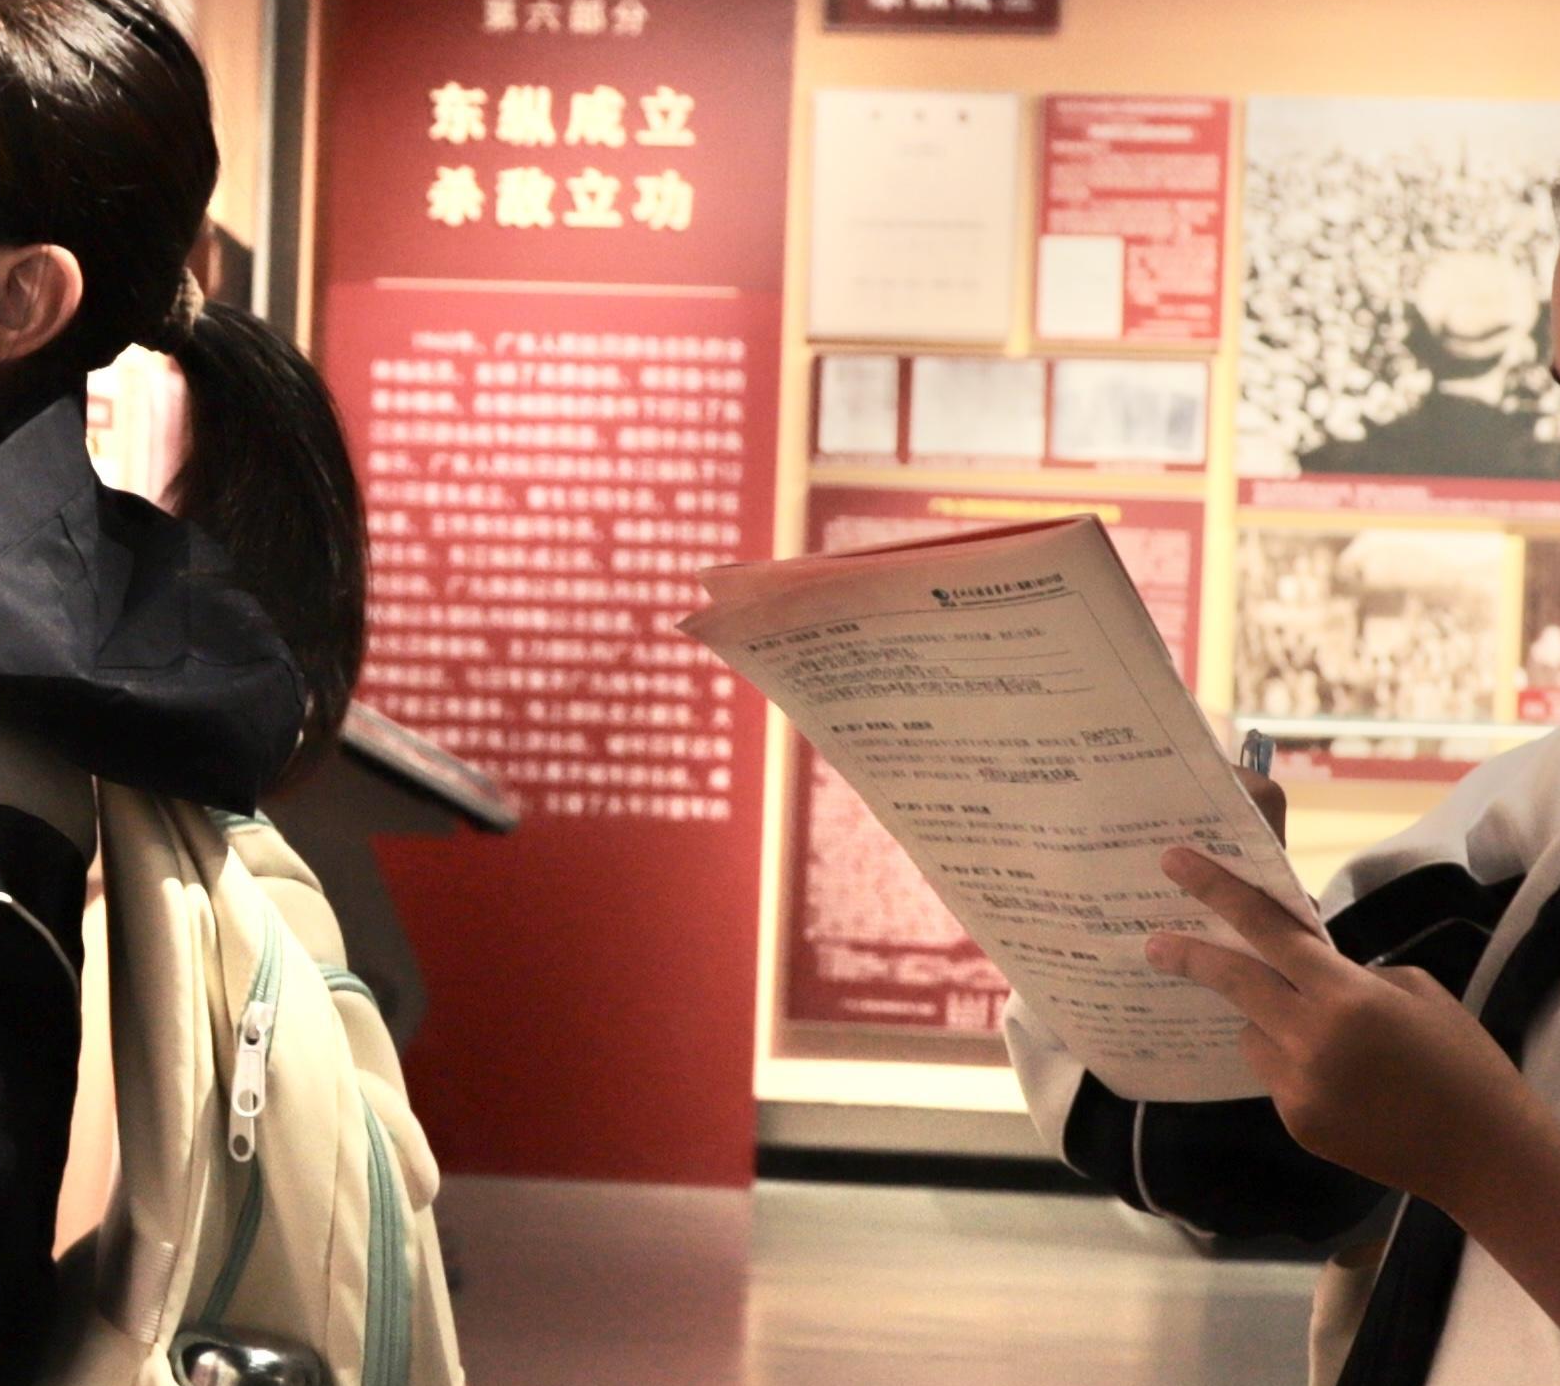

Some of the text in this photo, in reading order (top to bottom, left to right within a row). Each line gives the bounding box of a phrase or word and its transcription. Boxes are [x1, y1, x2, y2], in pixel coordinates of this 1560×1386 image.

[427, 81, 696, 148] 东纵成立
[426, 164, 695, 231] 杀敌立功
